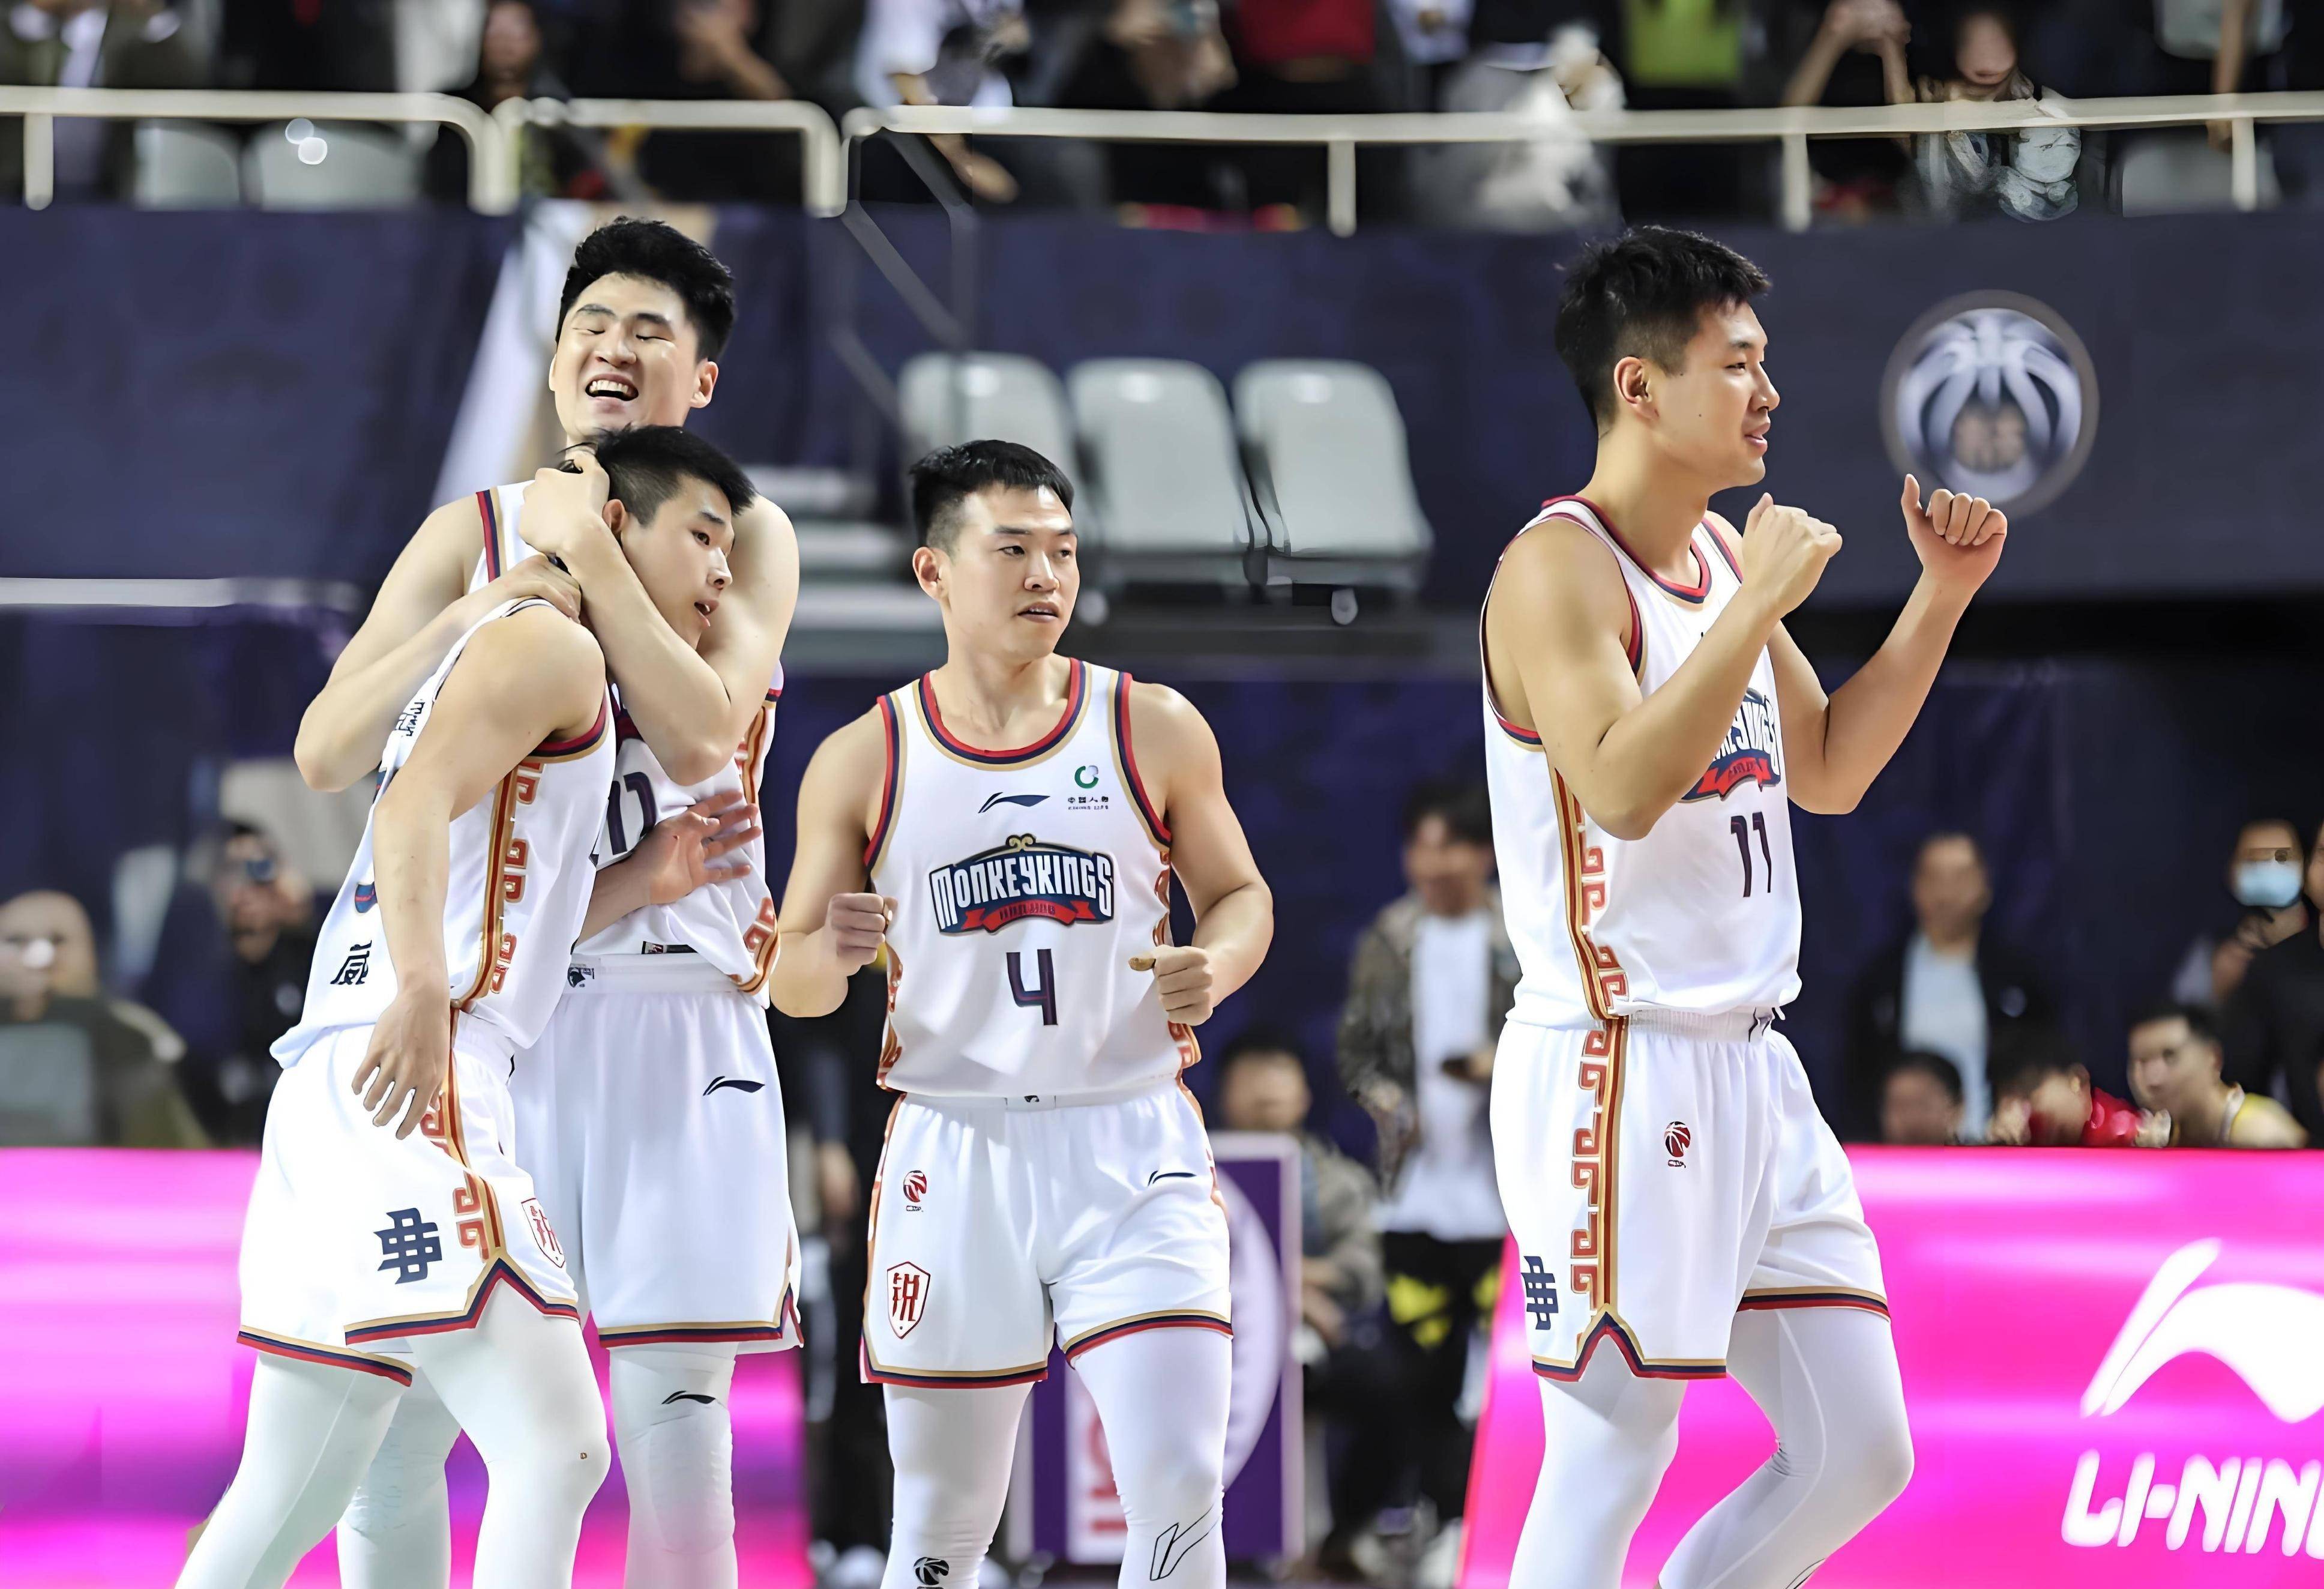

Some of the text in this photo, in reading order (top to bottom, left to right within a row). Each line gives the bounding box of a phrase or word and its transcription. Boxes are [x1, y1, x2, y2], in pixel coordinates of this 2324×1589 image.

[931, 854, 1112, 930] MONKEYKINGS
[1730, 812, 1772, 897] 11
[1007, 948, 1058, 1026] 4
